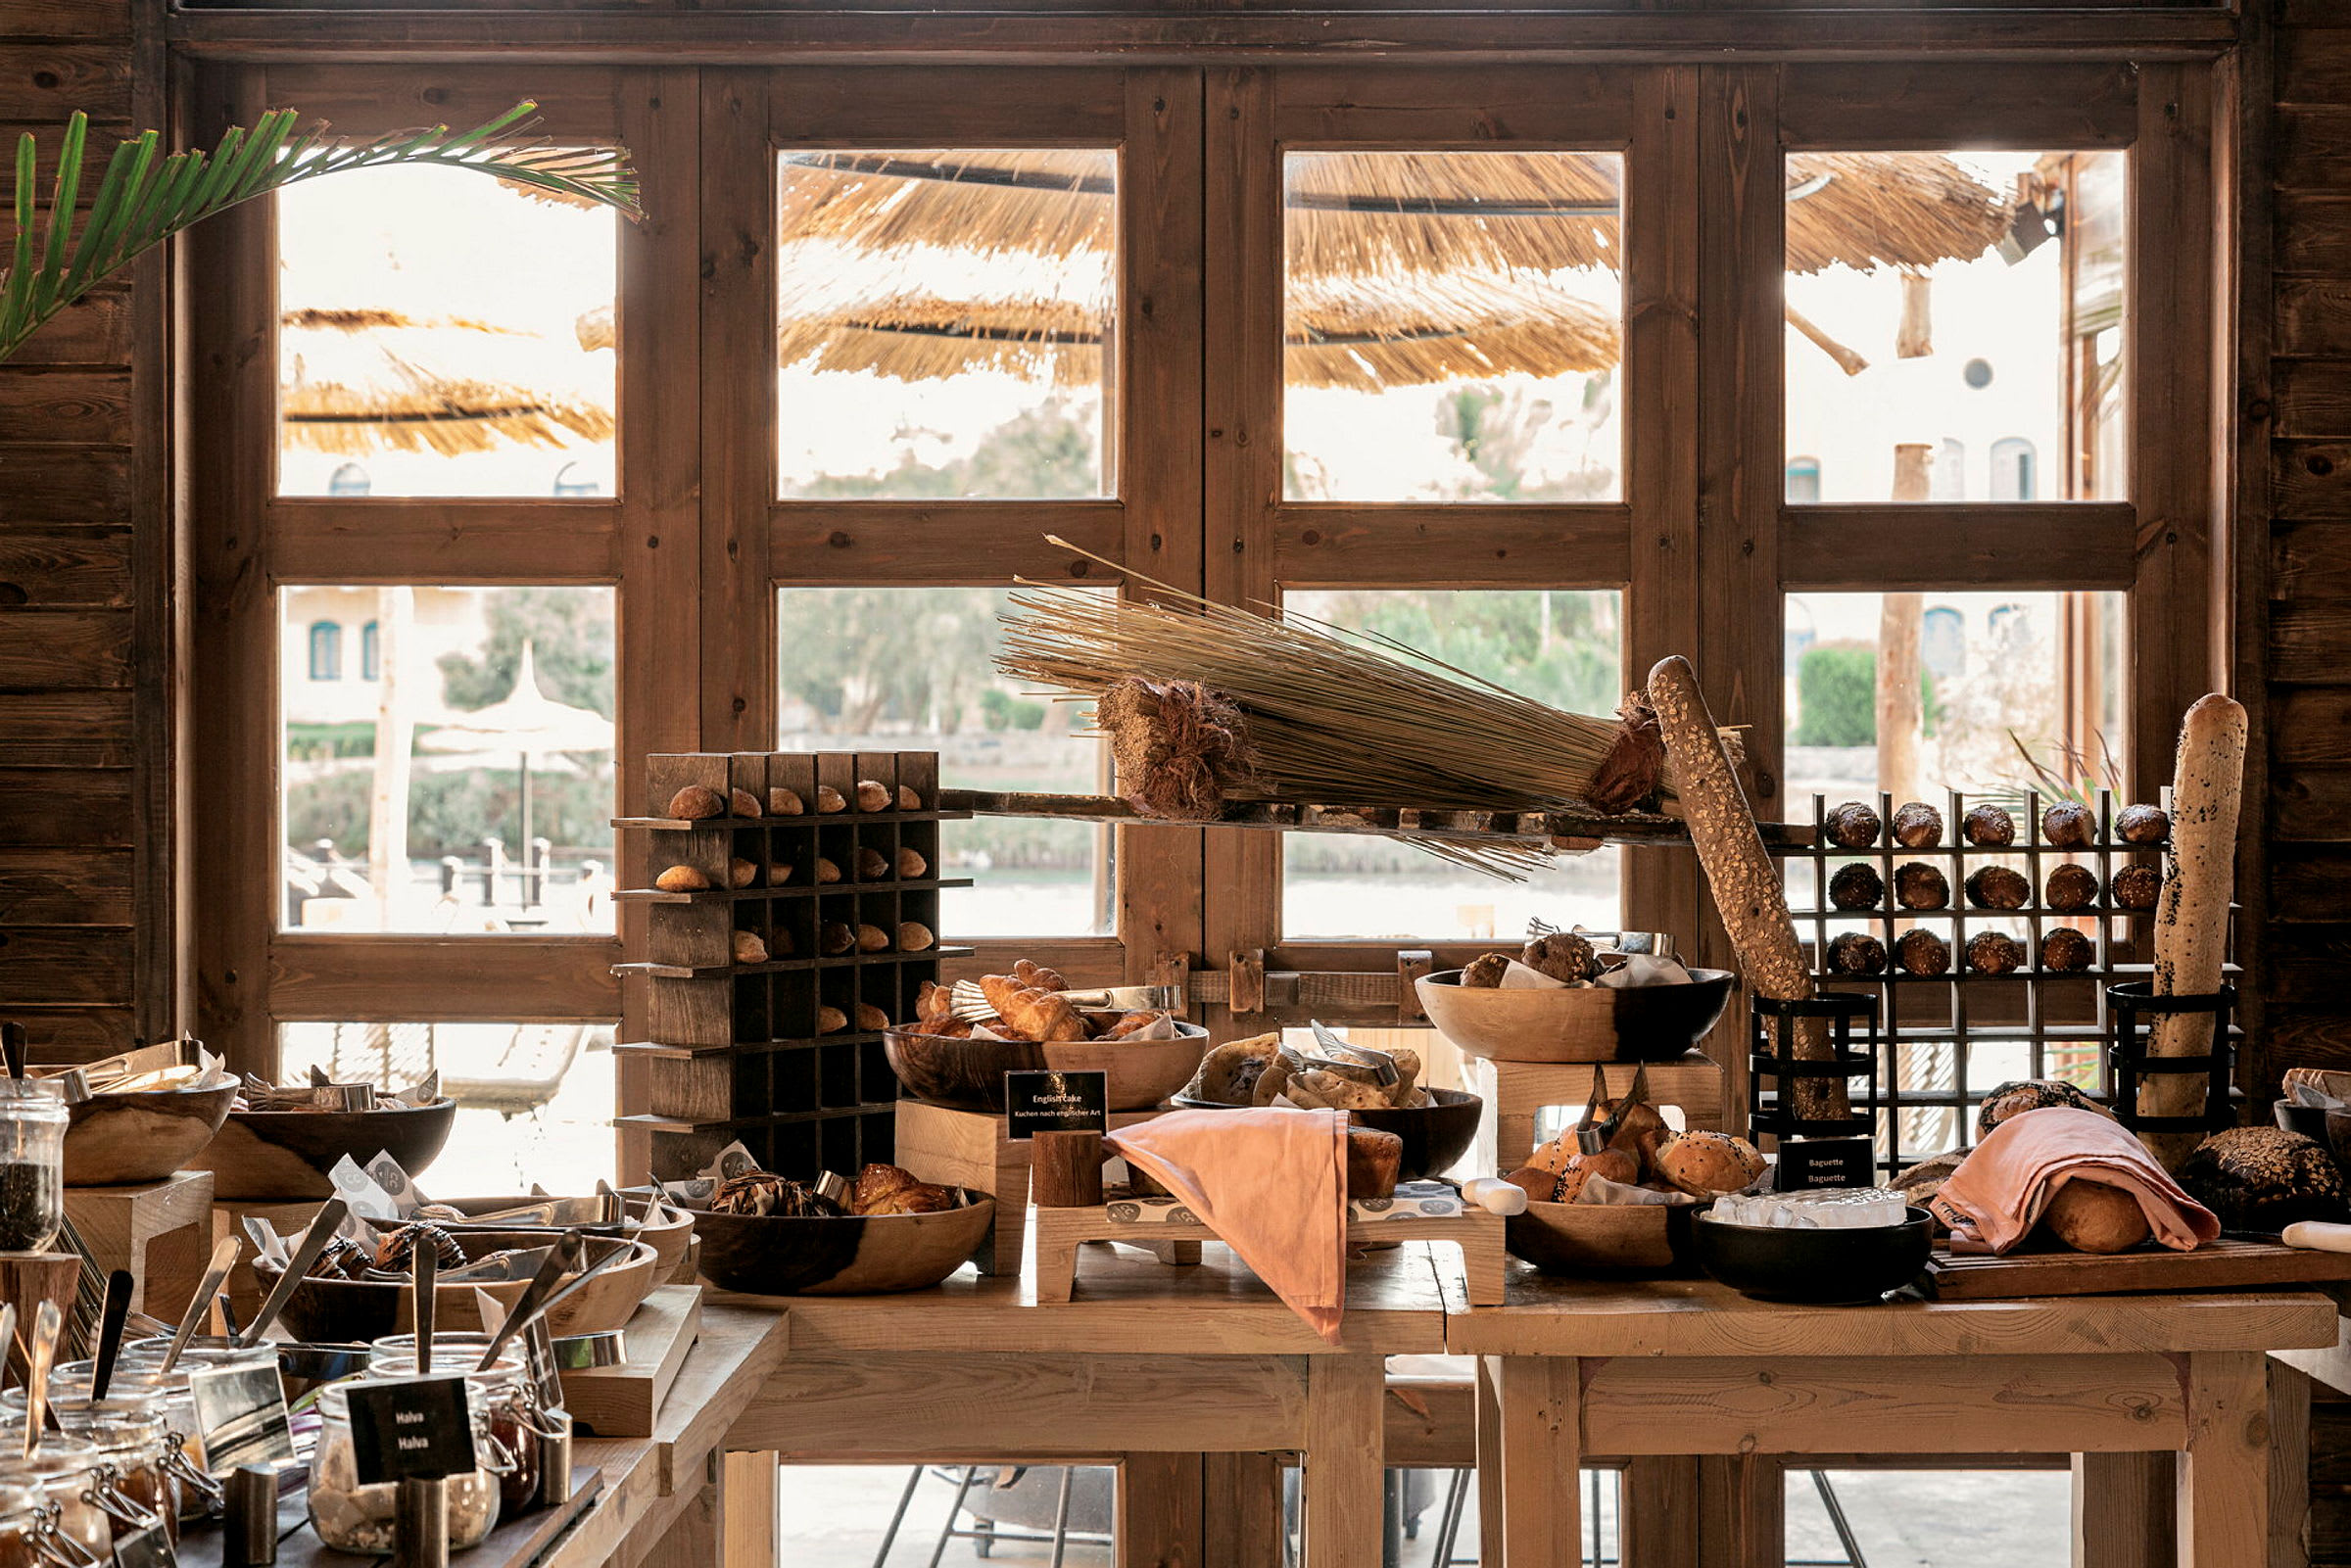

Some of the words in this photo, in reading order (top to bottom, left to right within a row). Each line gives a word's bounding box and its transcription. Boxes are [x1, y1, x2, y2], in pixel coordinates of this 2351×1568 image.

[1032, 1094, 1061, 1105] English
[1808, 1159, 1844, 1167] Baguette
[1807, 1174, 1846, 1184] Baguette
[396, 1411, 424, 1424] Halva
[398, 1436, 429, 1450] Halva
